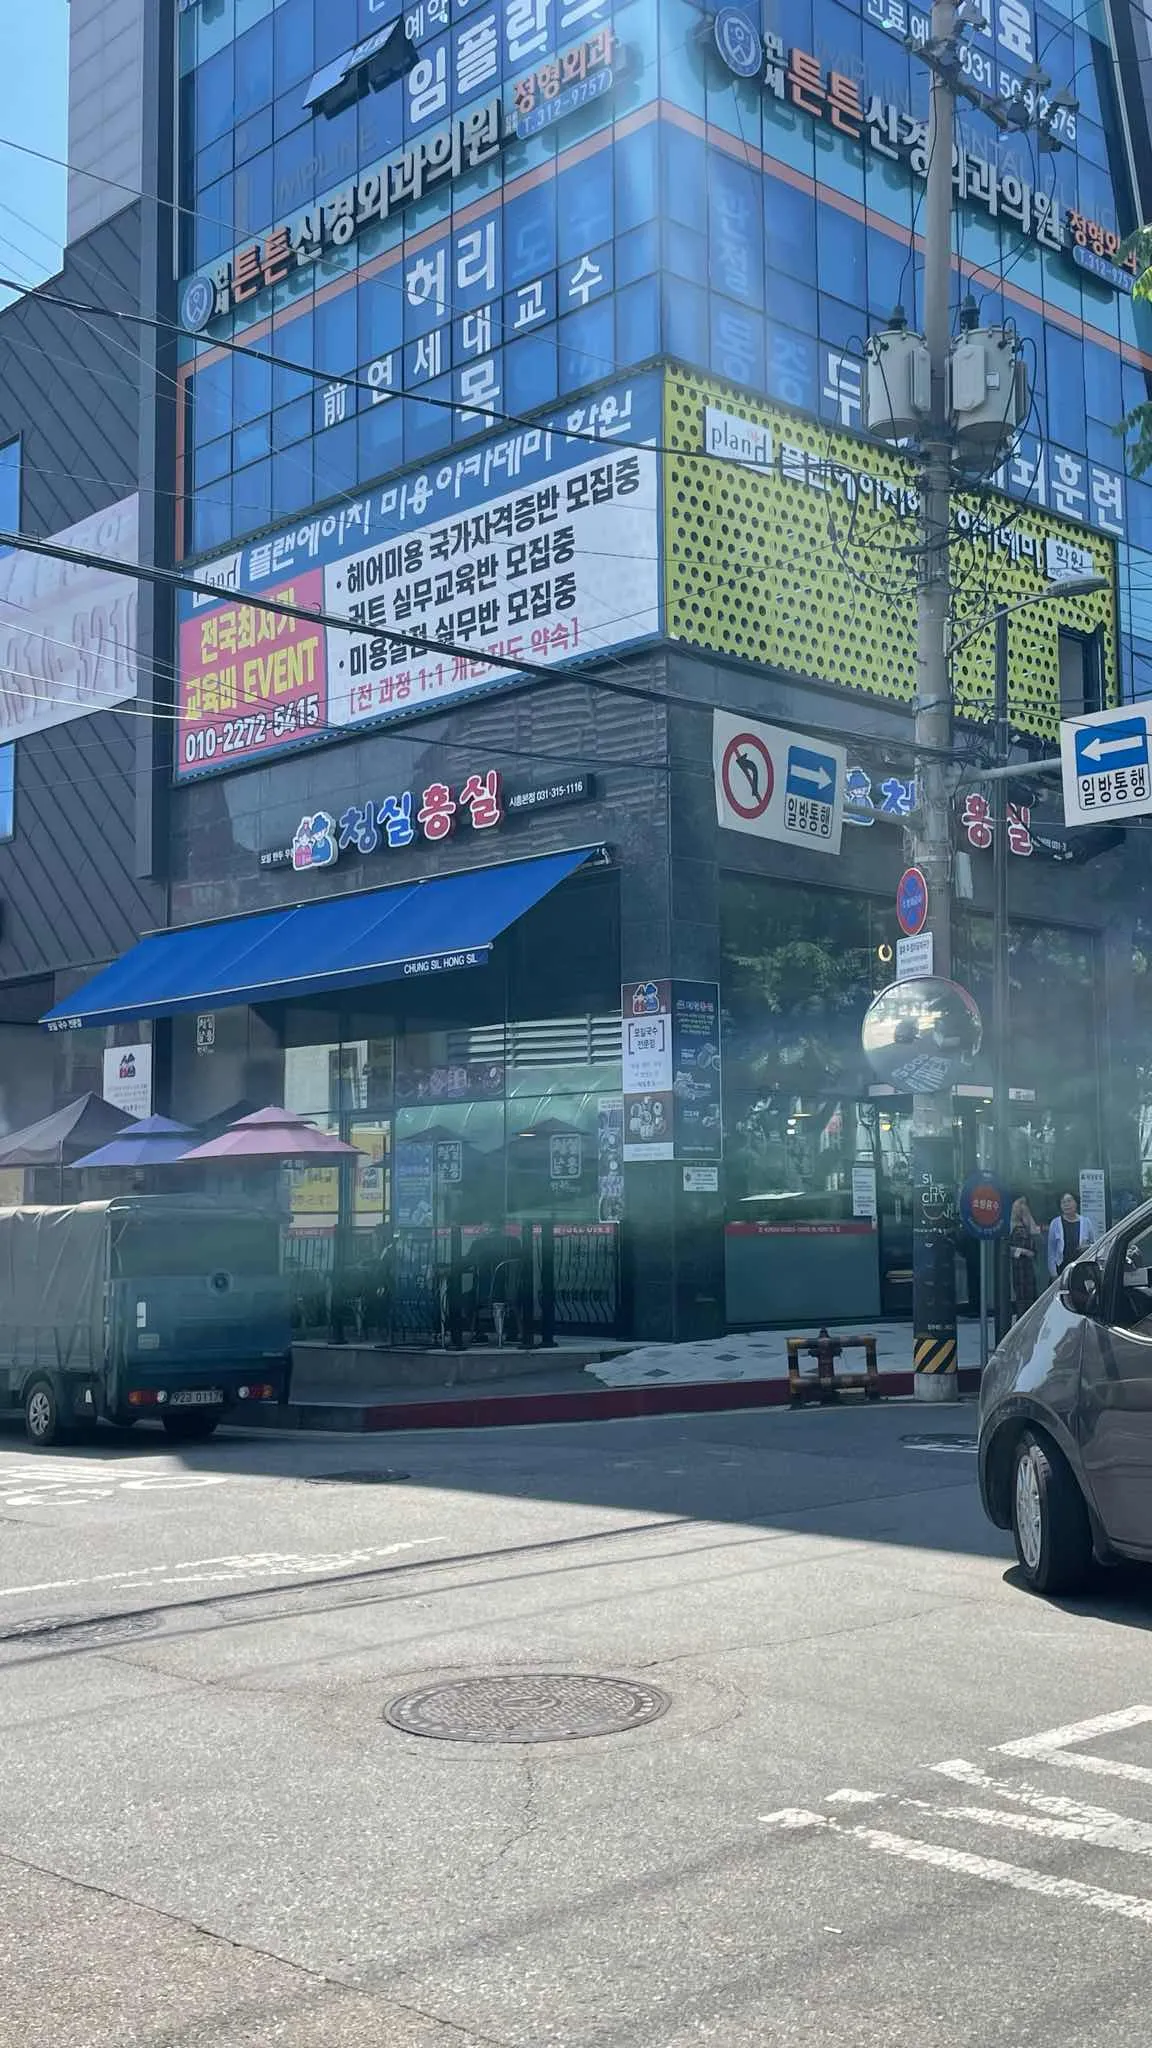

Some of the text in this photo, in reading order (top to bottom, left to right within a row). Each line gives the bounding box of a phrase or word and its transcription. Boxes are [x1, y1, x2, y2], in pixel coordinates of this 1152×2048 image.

[514, 27, 614, 113] 정형외과
[232, 99, 499, 303] 튼튼신경외과의원
[406, 221, 496, 316] 허리
[323, 383, 347, 427] 前
[455, 359, 501, 429] 목
[249, 500, 371, 581] 플랜에이치
[565, 390, 633, 444] 학원
[346, 455, 640, 594] 헤어미용 국가자격증반 모집중
[393, 553, 499, 621] 실무교육반
[505, 525, 576, 581] 모집중
[435, 598, 501, 646] 실무반
[507, 571, 577, 626] 모집중
[186, 636, 320, 721] 교육비 EVENT
[378, 670, 411, 705] 과정
[418, 663, 444, 690] 1:1
[185, 694, 320, 764] 010-2272-5415
[338, 770, 501, 853] 청실홍실
[787, 797, 831, 836] 일방통행
[1081, 768, 1146, 807] 일방통행
[404, 953, 478, 974] CHUNG SIL HONG SIL
